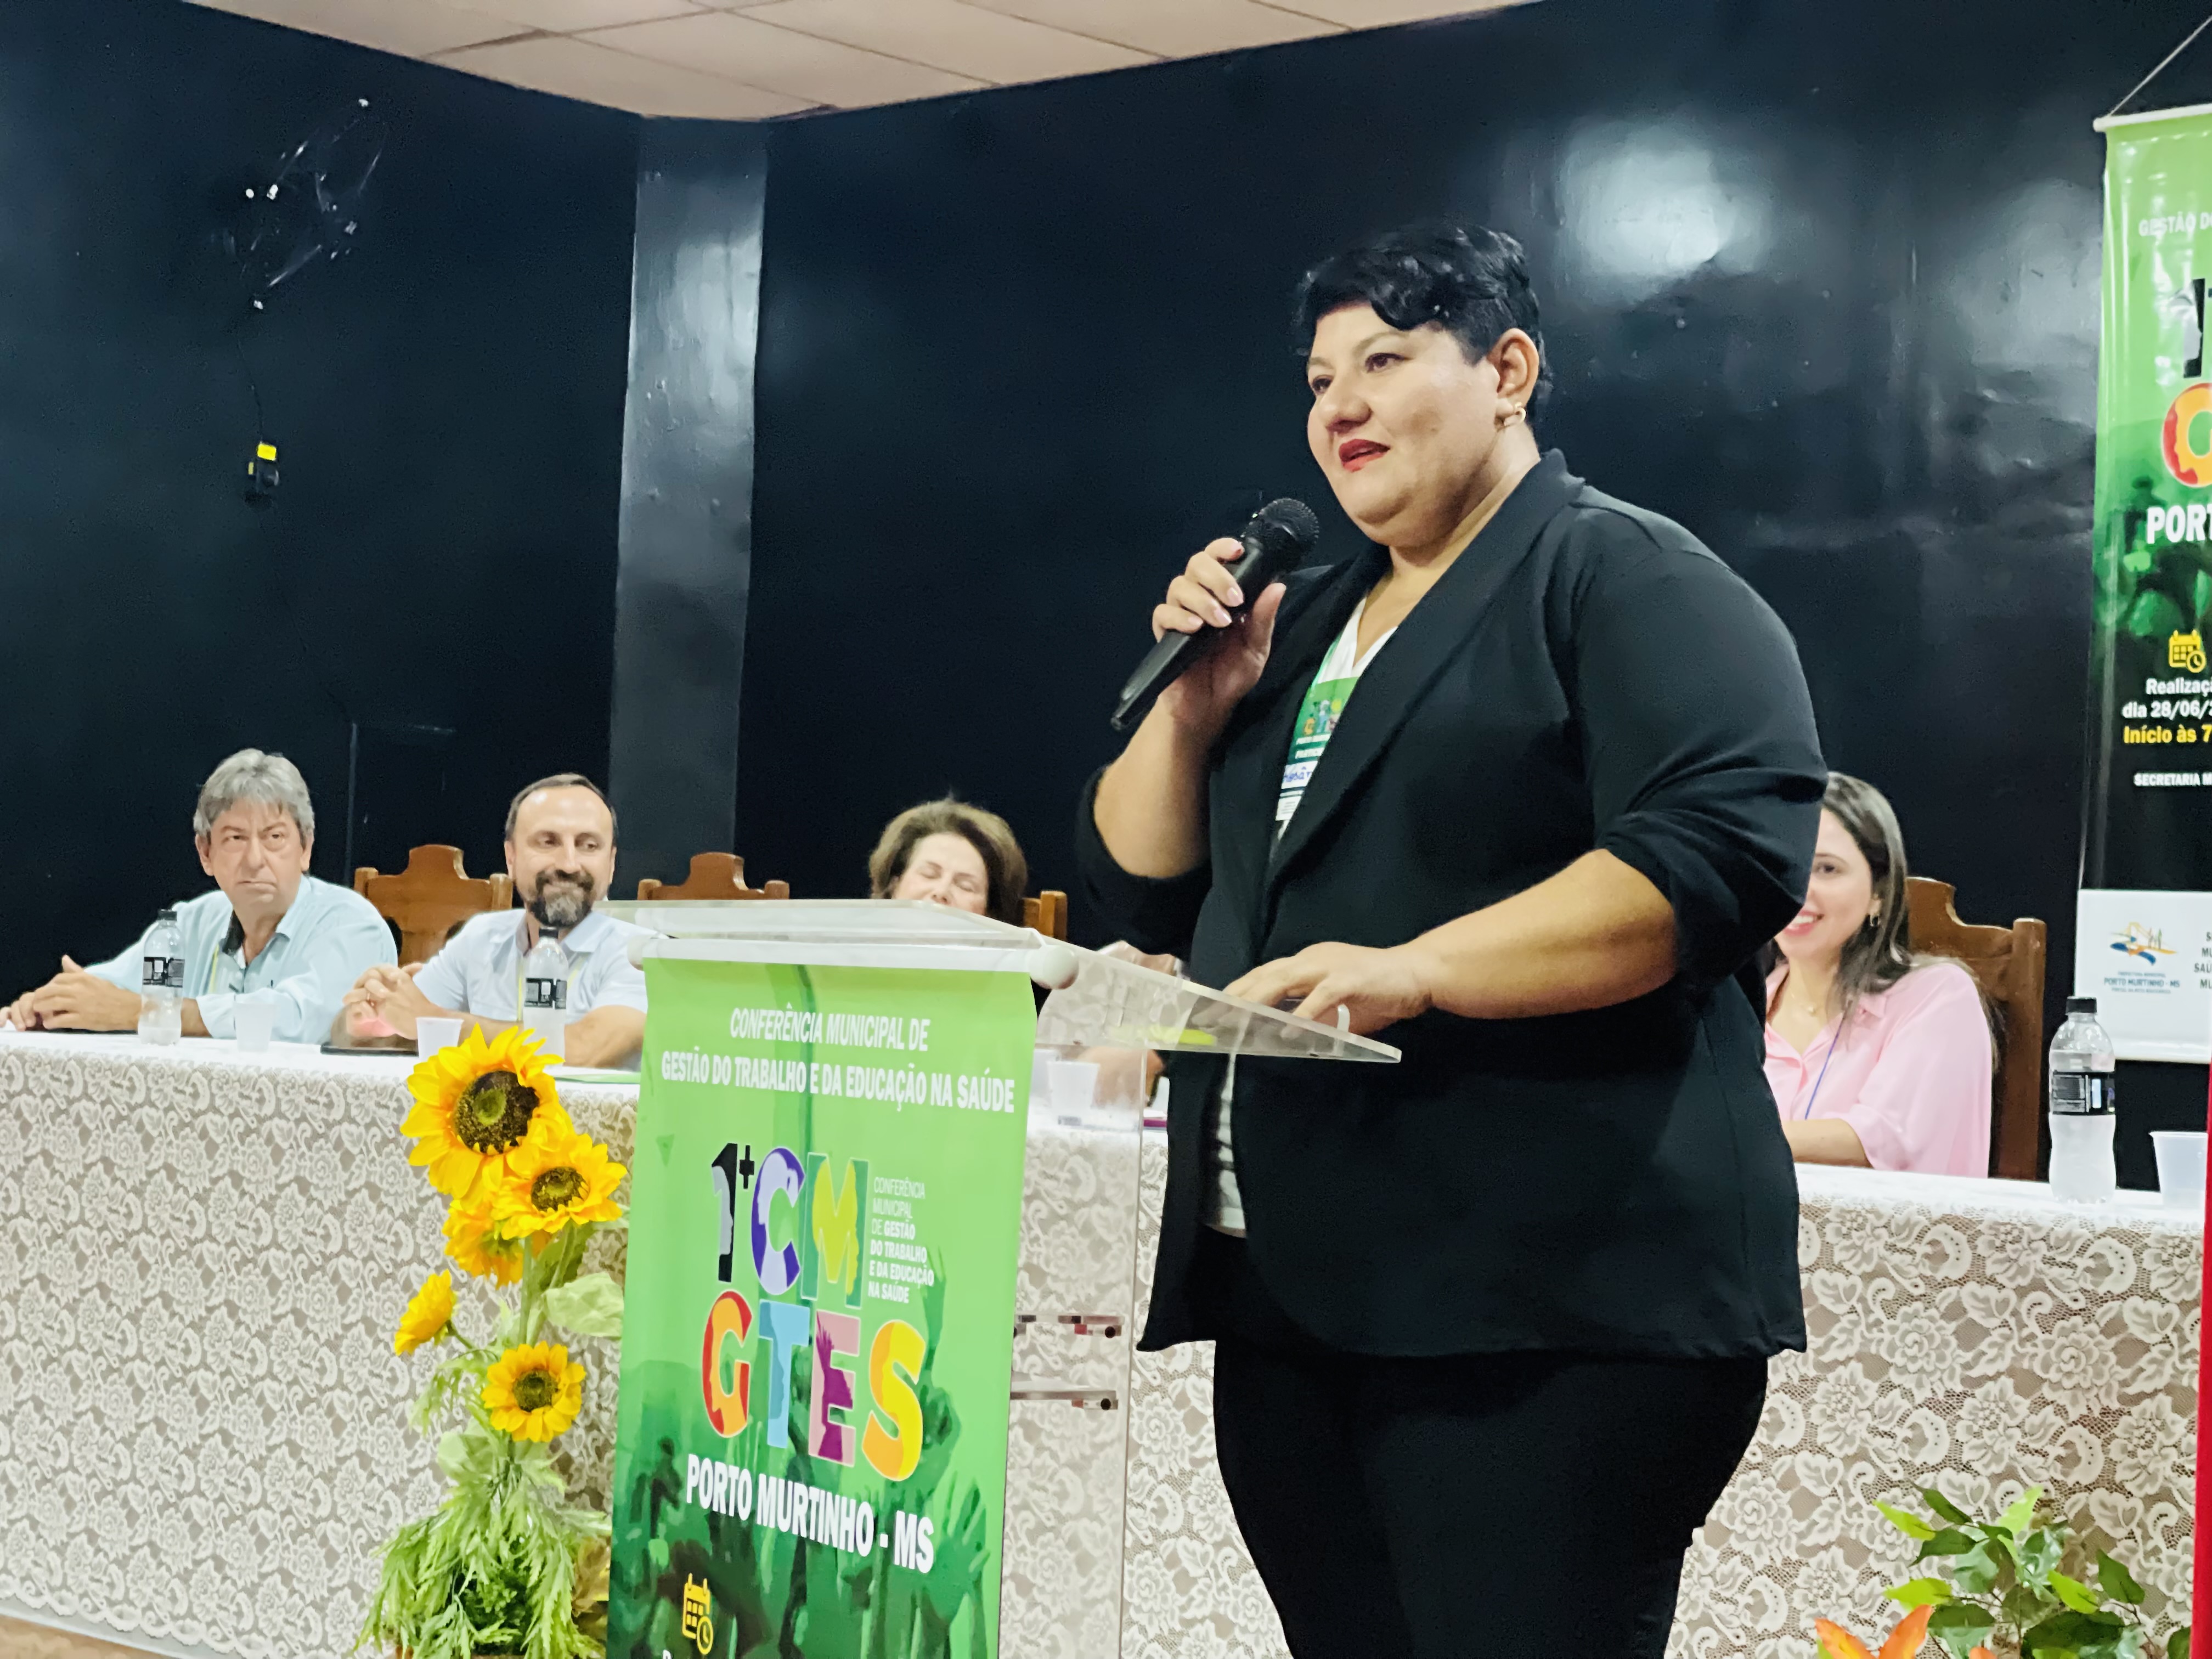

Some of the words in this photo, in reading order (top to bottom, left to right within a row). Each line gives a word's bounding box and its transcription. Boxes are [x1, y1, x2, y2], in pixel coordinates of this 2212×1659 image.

[2138, 211, 2196, 237] GESTÃO
[2146, 676, 2212, 697] Realizaç
[2122, 701, 2147, 719] dia
[2124, 724, 2172, 744] Início
[2176, 724, 2197, 743] às
[2133, 772, 2200, 787] SECRETARIA
[730, 1002, 823, 1043] CONFERÊNCIA
[826, 1013, 905, 1050] MUNICIPAL
[908, 1018, 931, 1052] DE
[662, 1046, 709, 1084] GESTÃO
[712, 1054, 732, 1086] DO
[735, 1056, 807, 1093] TRABALHO
[810, 1062, 820, 1094] E
[822, 1064, 843, 1097] DA
[846, 1062, 927, 1112] EDUCAÇÃO
[930, 1073, 953, 1107] NA
[956, 1067, 1015, 1113] SAÚDE
[873, 1176, 926, 1199] CONFERÊNCIA
[872, 1198, 913, 1219] MUNICIPAL
[871, 1218, 883, 1235] DE
[884, 1219, 916, 1240] GESTÃO
[870, 1239, 883, 1256] DO
[884, 1241, 928, 1263] TRABALHO
[869, 1260, 875, 1276] E
[876, 1261, 888, 1278] DA
[889, 1263, 935, 1289] EDUCAÇÃO
[868, 1280, 880, 1298] NA
[881, 1281, 910, 1304] SAÚDE
[702, 1289, 927, 1482] GTES
[686, 1453, 753, 1521] PORTO
[756, 1473, 874, 1557] MURTINHO
[893, 1510, 934, 1573] MS
